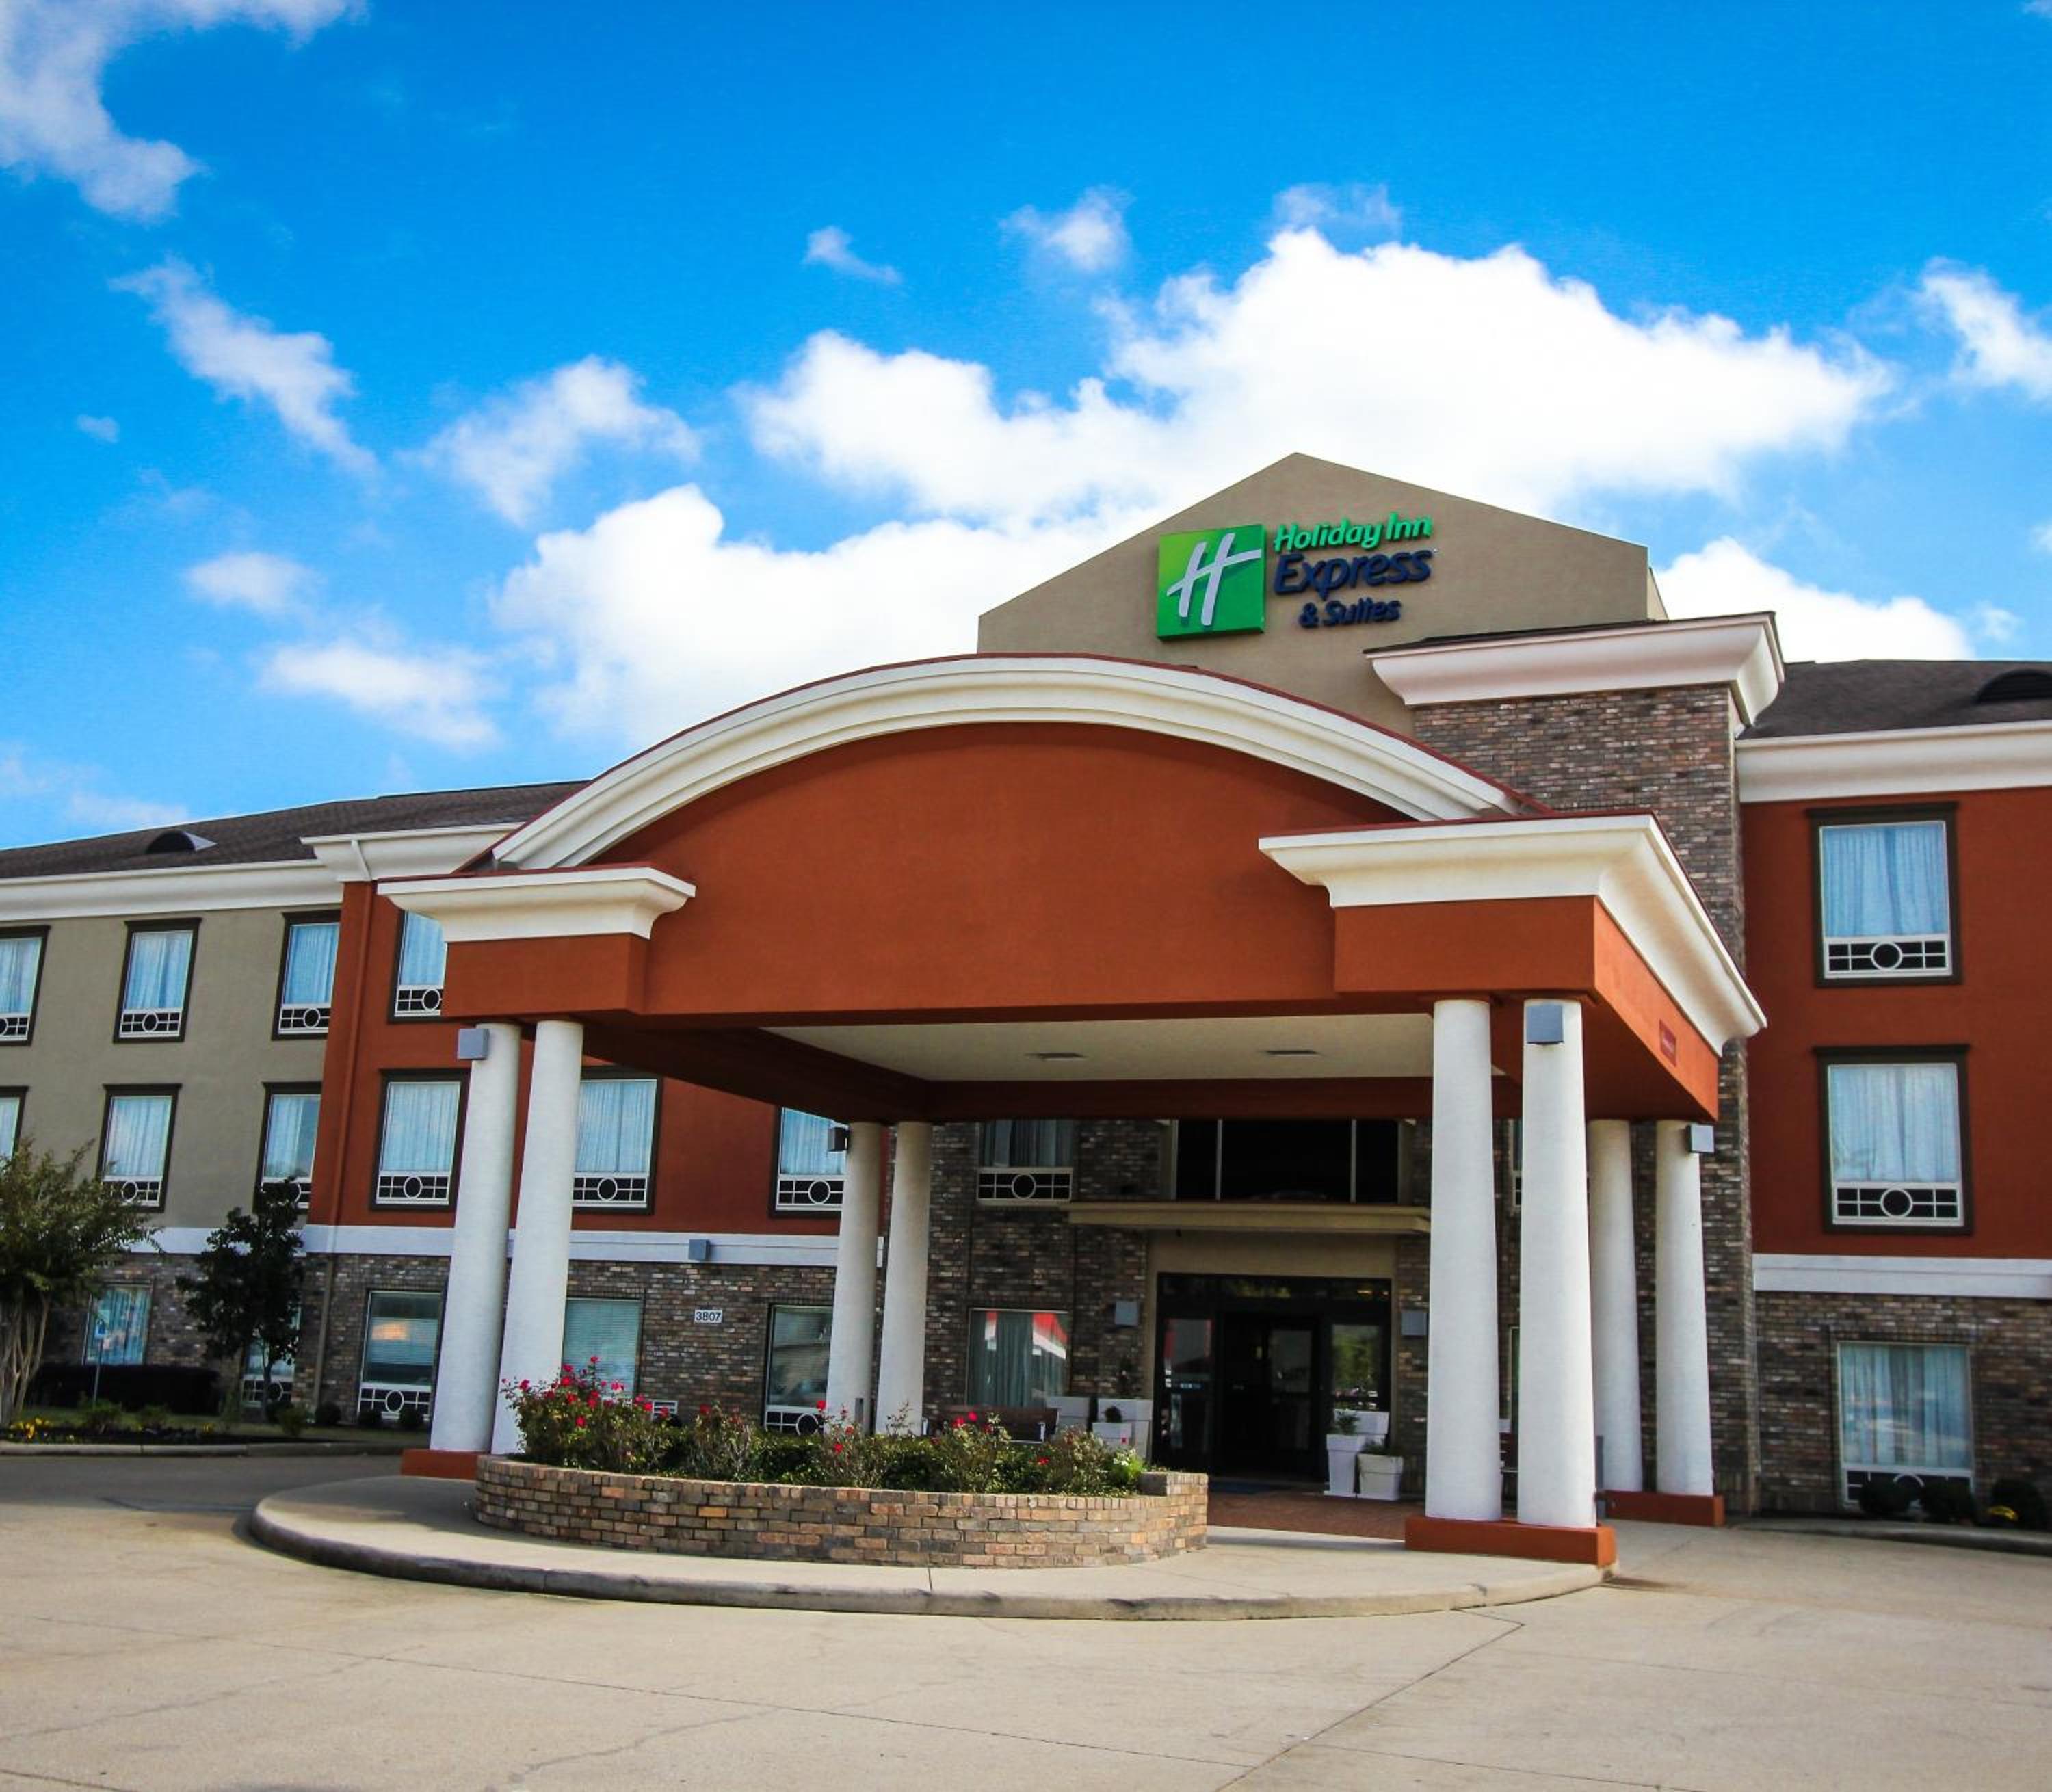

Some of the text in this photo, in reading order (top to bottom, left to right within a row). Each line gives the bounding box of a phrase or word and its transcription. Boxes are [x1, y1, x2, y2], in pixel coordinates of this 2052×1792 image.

[1274, 512, 1433, 553] Holiday Inn
[1274, 550, 1433, 601] Express
[1298, 597, 1402, 629] & Suites
[696, 1312, 722, 1321] 3807
